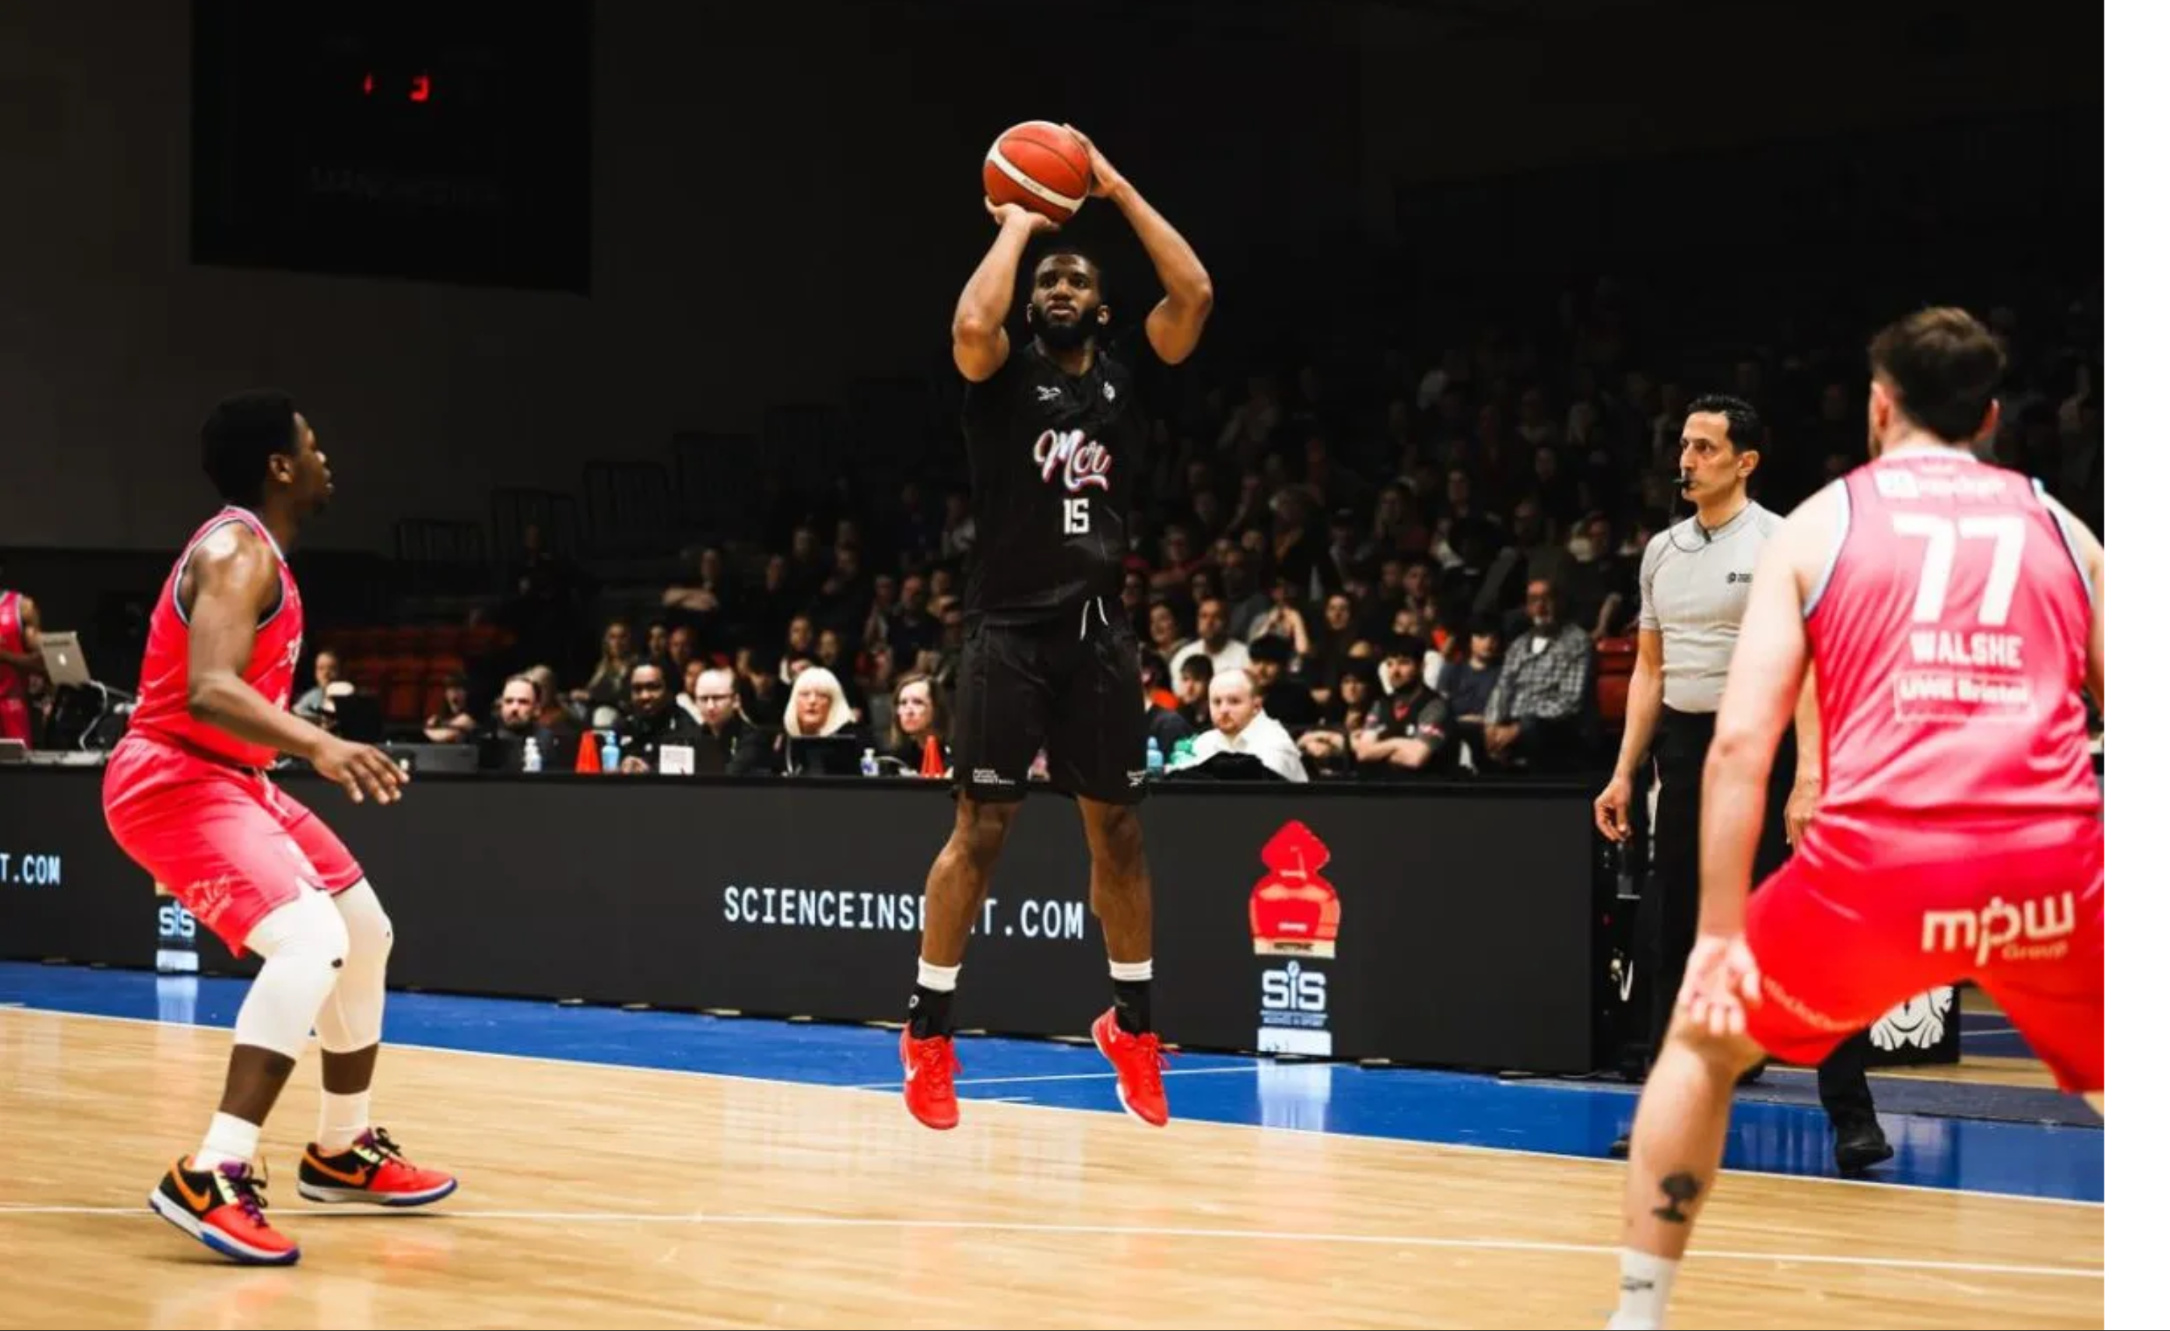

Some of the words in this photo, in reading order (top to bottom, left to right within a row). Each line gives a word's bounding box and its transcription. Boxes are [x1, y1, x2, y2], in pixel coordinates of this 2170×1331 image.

[1063, 498, 1090, 534] 15
[1893, 514, 2026, 625] 77
[1910, 630, 2024, 668] WALSHE
[723, 886, 1085, 940] SCIENCEINST.COM
